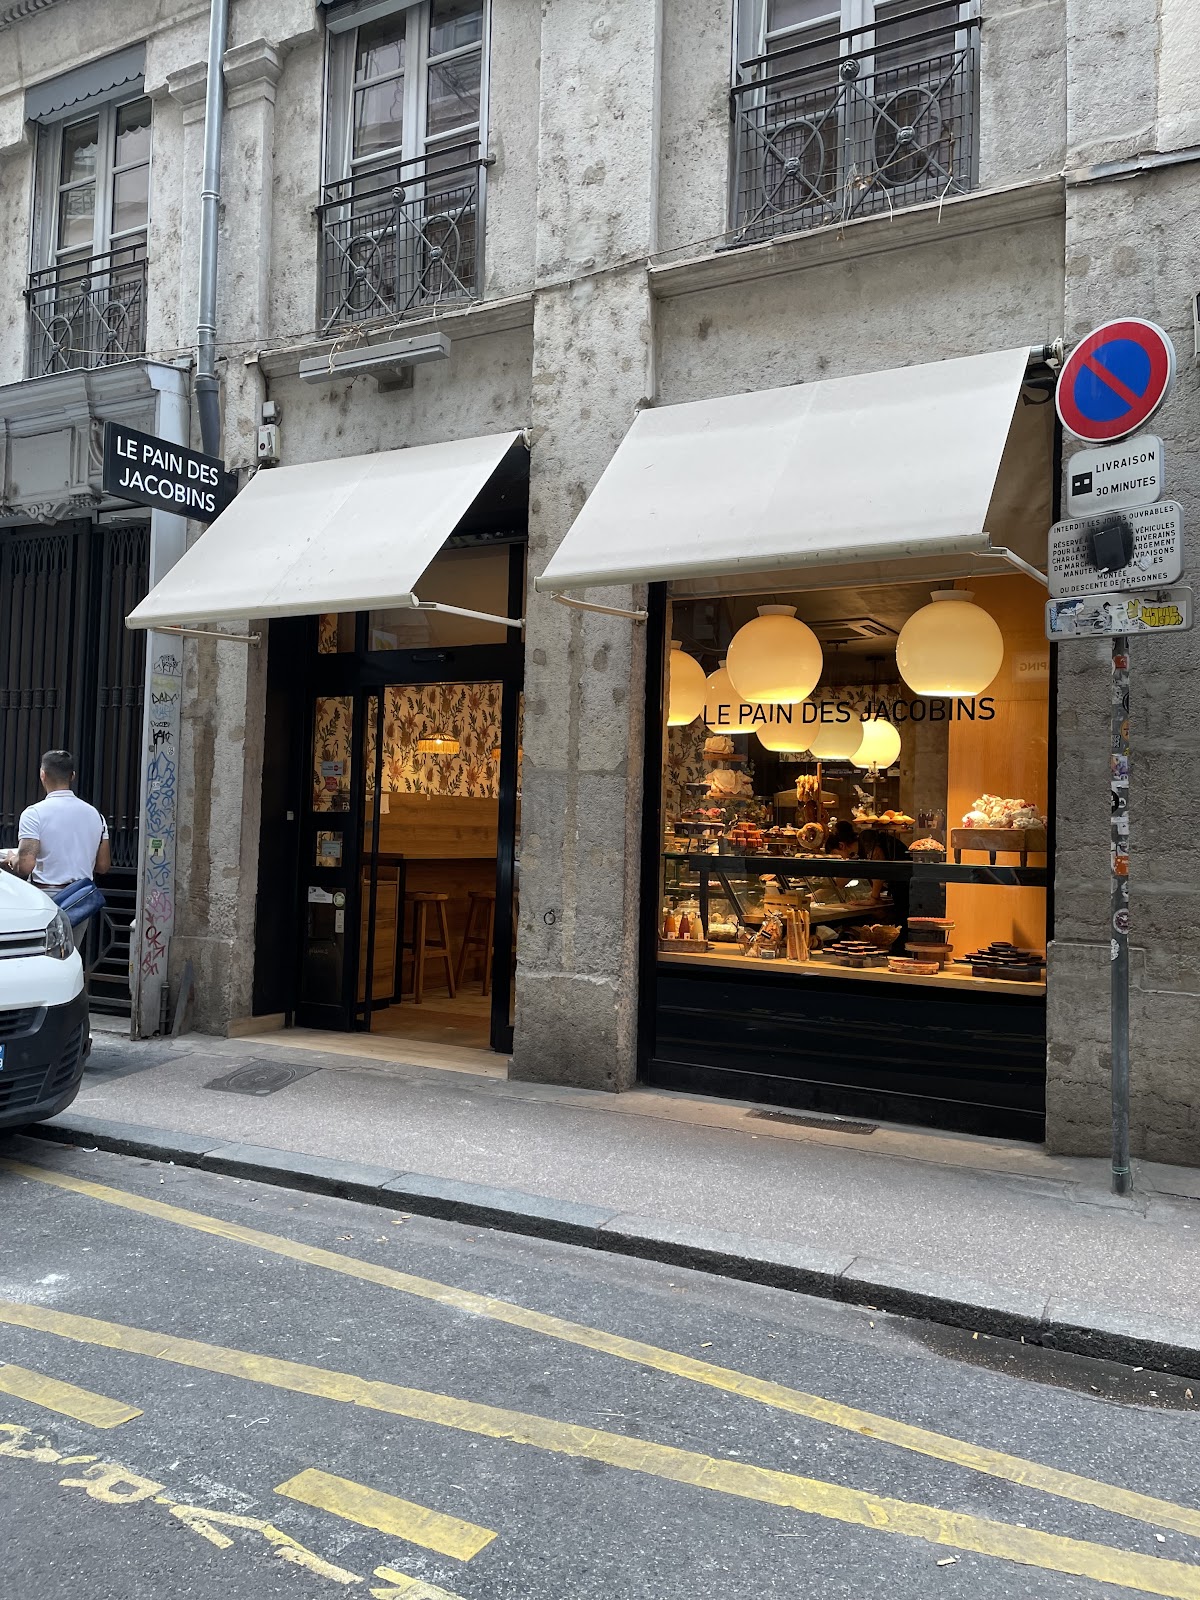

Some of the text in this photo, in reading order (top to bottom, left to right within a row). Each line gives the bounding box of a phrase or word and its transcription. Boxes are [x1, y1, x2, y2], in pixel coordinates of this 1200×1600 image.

[116, 435, 219, 487] LE PAIN DES
[1095, 451, 1155, 473] LIVRAISON
[118, 467, 216, 513] JACOBINS
[1096, 475, 1156, 497] 30 MINUTES
[1053, 522, 1085, 534] INTERDIT
[1087, 519, 1100, 528] LES
[1102, 514, 1127, 525] JOURS
[1128, 504, 1174, 520] OUVRABLES
[1135, 529, 1176, 543] RIVERAINS
[1051, 552, 1090, 565] CHARGEME
[1052, 548, 1071, 557] POUR
[1072, 546, 1080, 554] LA
[1132, 546, 1175, 559] IVRAISONS
[1053, 564, 1063, 572] DE
[1063, 566, 1100, 578] MANUTEN
[1060, 586, 1070, 594] OU
[1071, 581, 1108, 592] DESCENTE
[1109, 579, 1119, 587] DE
[703, 697, 996, 725] LE PAIN DES JACOBINS
